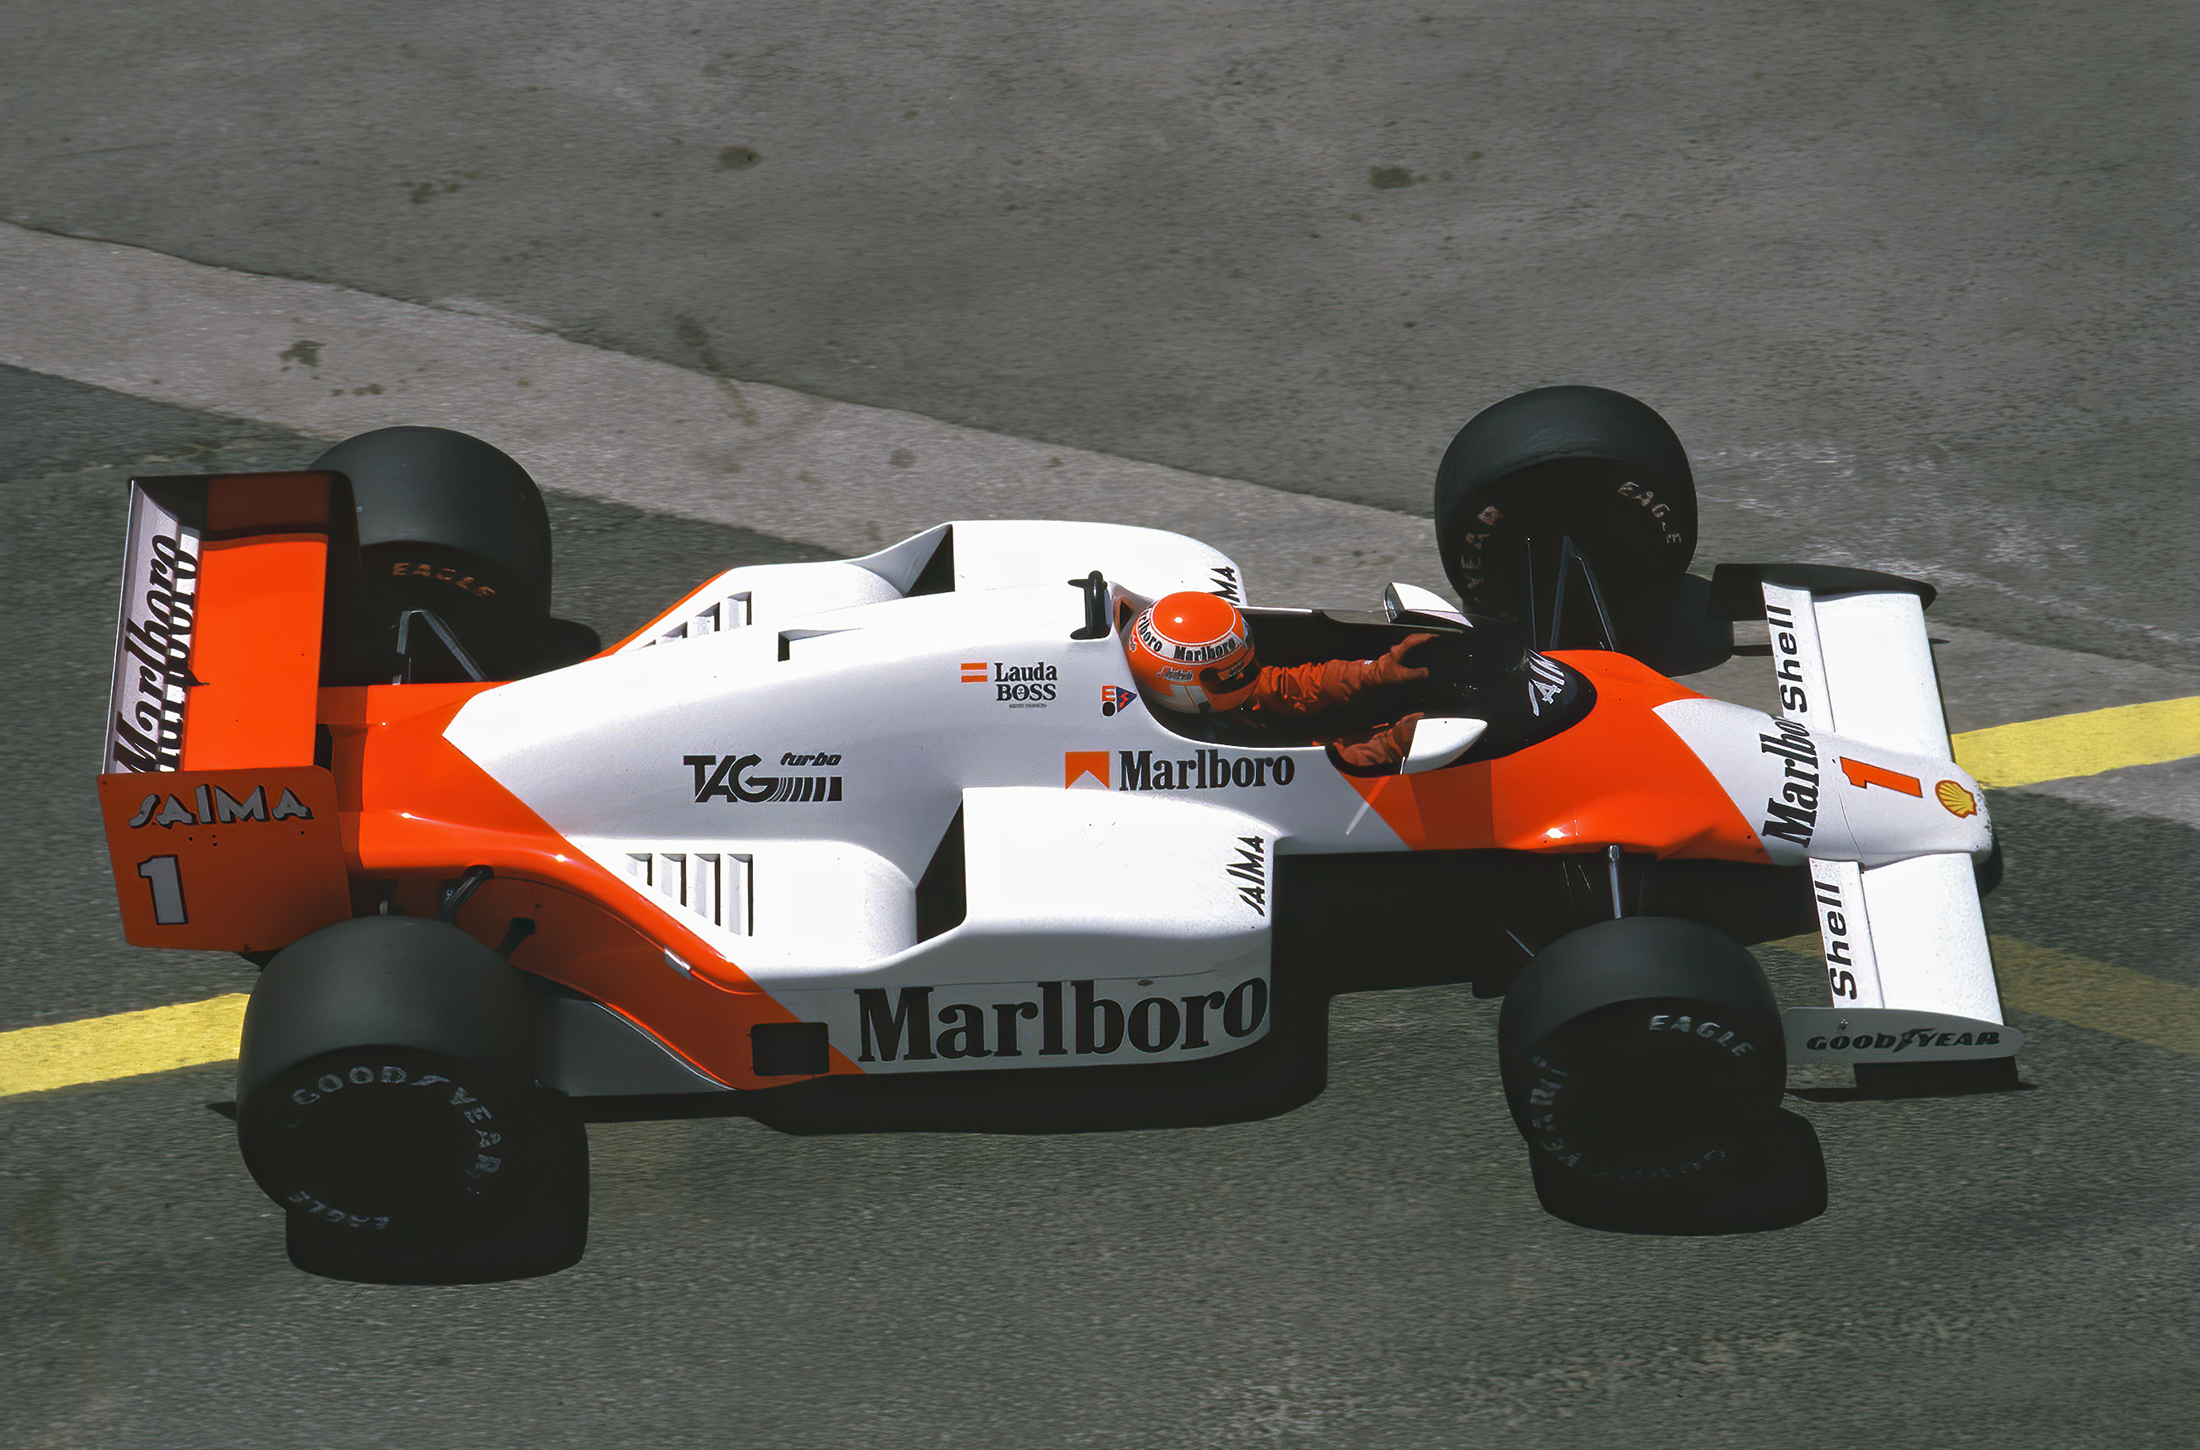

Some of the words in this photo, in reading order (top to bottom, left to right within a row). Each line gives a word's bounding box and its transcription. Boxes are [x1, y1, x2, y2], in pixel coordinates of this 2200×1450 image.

[993, 661, 1058, 683] Lauda
[1173, 637, 1237, 662] Marlboro
[1766, 604, 1808, 713] Shell
[995, 683, 1057, 702] BOSS
[682, 753, 780, 803] TAG
[779, 751, 843, 767] turbo
[1118, 748, 1296, 792] Marlboro
[1839, 755, 1924, 799] 1
[128, 783, 315, 830] SAIMA
[136, 853, 190, 926] 1
[1225, 835, 1266, 918] SAIMA
[1814, 880, 1858, 1001] Shell
[853, 976, 1269, 1063] Marlboro
[1647, 1013, 1755, 1058] EAGLE
[1806, 1027, 2001, 1054] GOODYEAR
